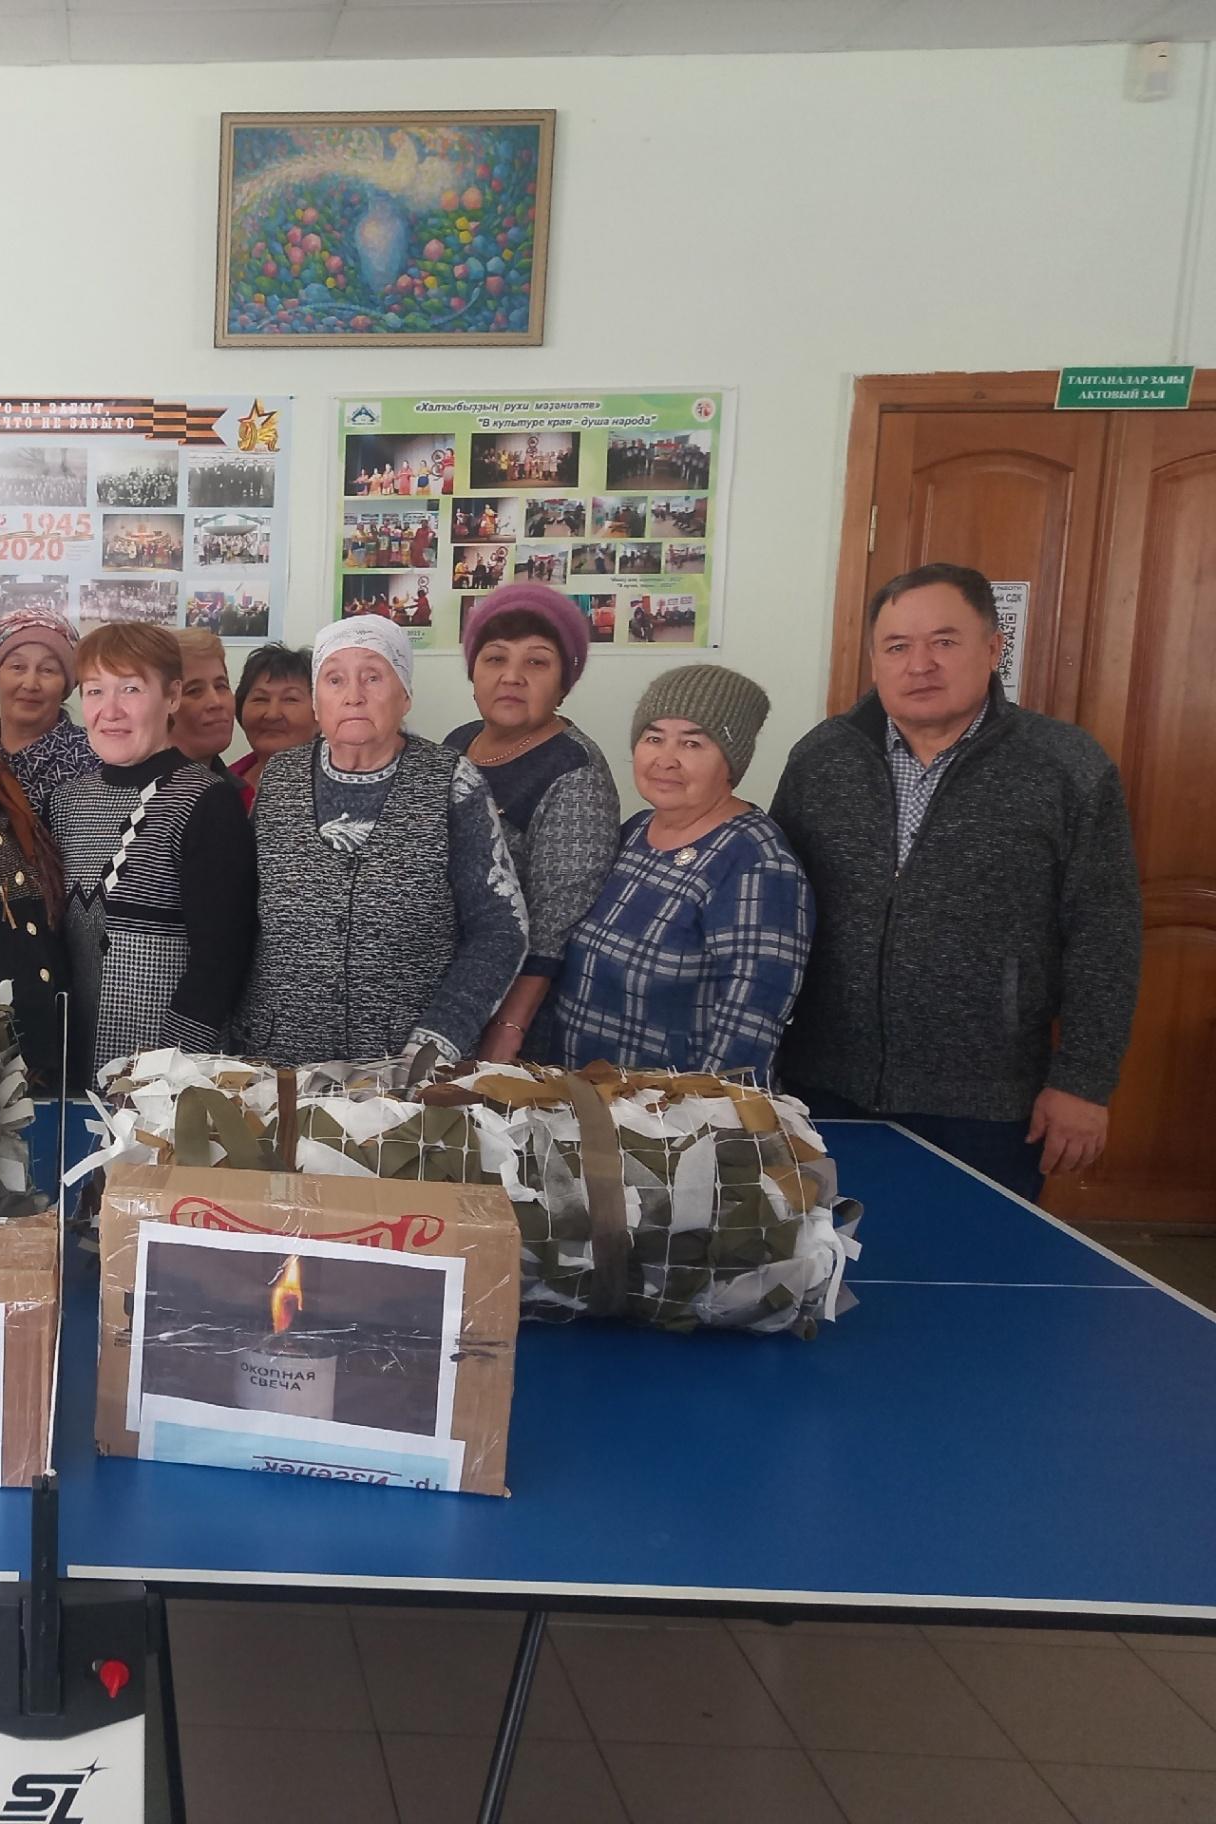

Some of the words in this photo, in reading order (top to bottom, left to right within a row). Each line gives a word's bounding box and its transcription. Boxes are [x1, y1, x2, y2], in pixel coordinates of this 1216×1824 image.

[1067, 375, 1149, 385] ТАНТАНАЛАР
[1078, 388, 1139, 399] АКТОВЫЙ
[1141, 390, 1166, 399] ЗАЛ
[21, 402, 41, 414] НЕ
[48, 402, 110, 416] ЗАБЫТ,
[503, 402, 530, 412] рухи
[41, 417, 61, 429] НЕ
[69, 417, 135, 429] ЗАБЫТО
[492, 419, 544, 429] культуре
[547, 418, 572, 428] края
[581, 416, 610, 428] душа
[22, 511, 92, 536] 1945
[240, 1362, 316, 1380] ОКОПНАЯ
[250, 1376, 301, 1391] СВЕЧА
